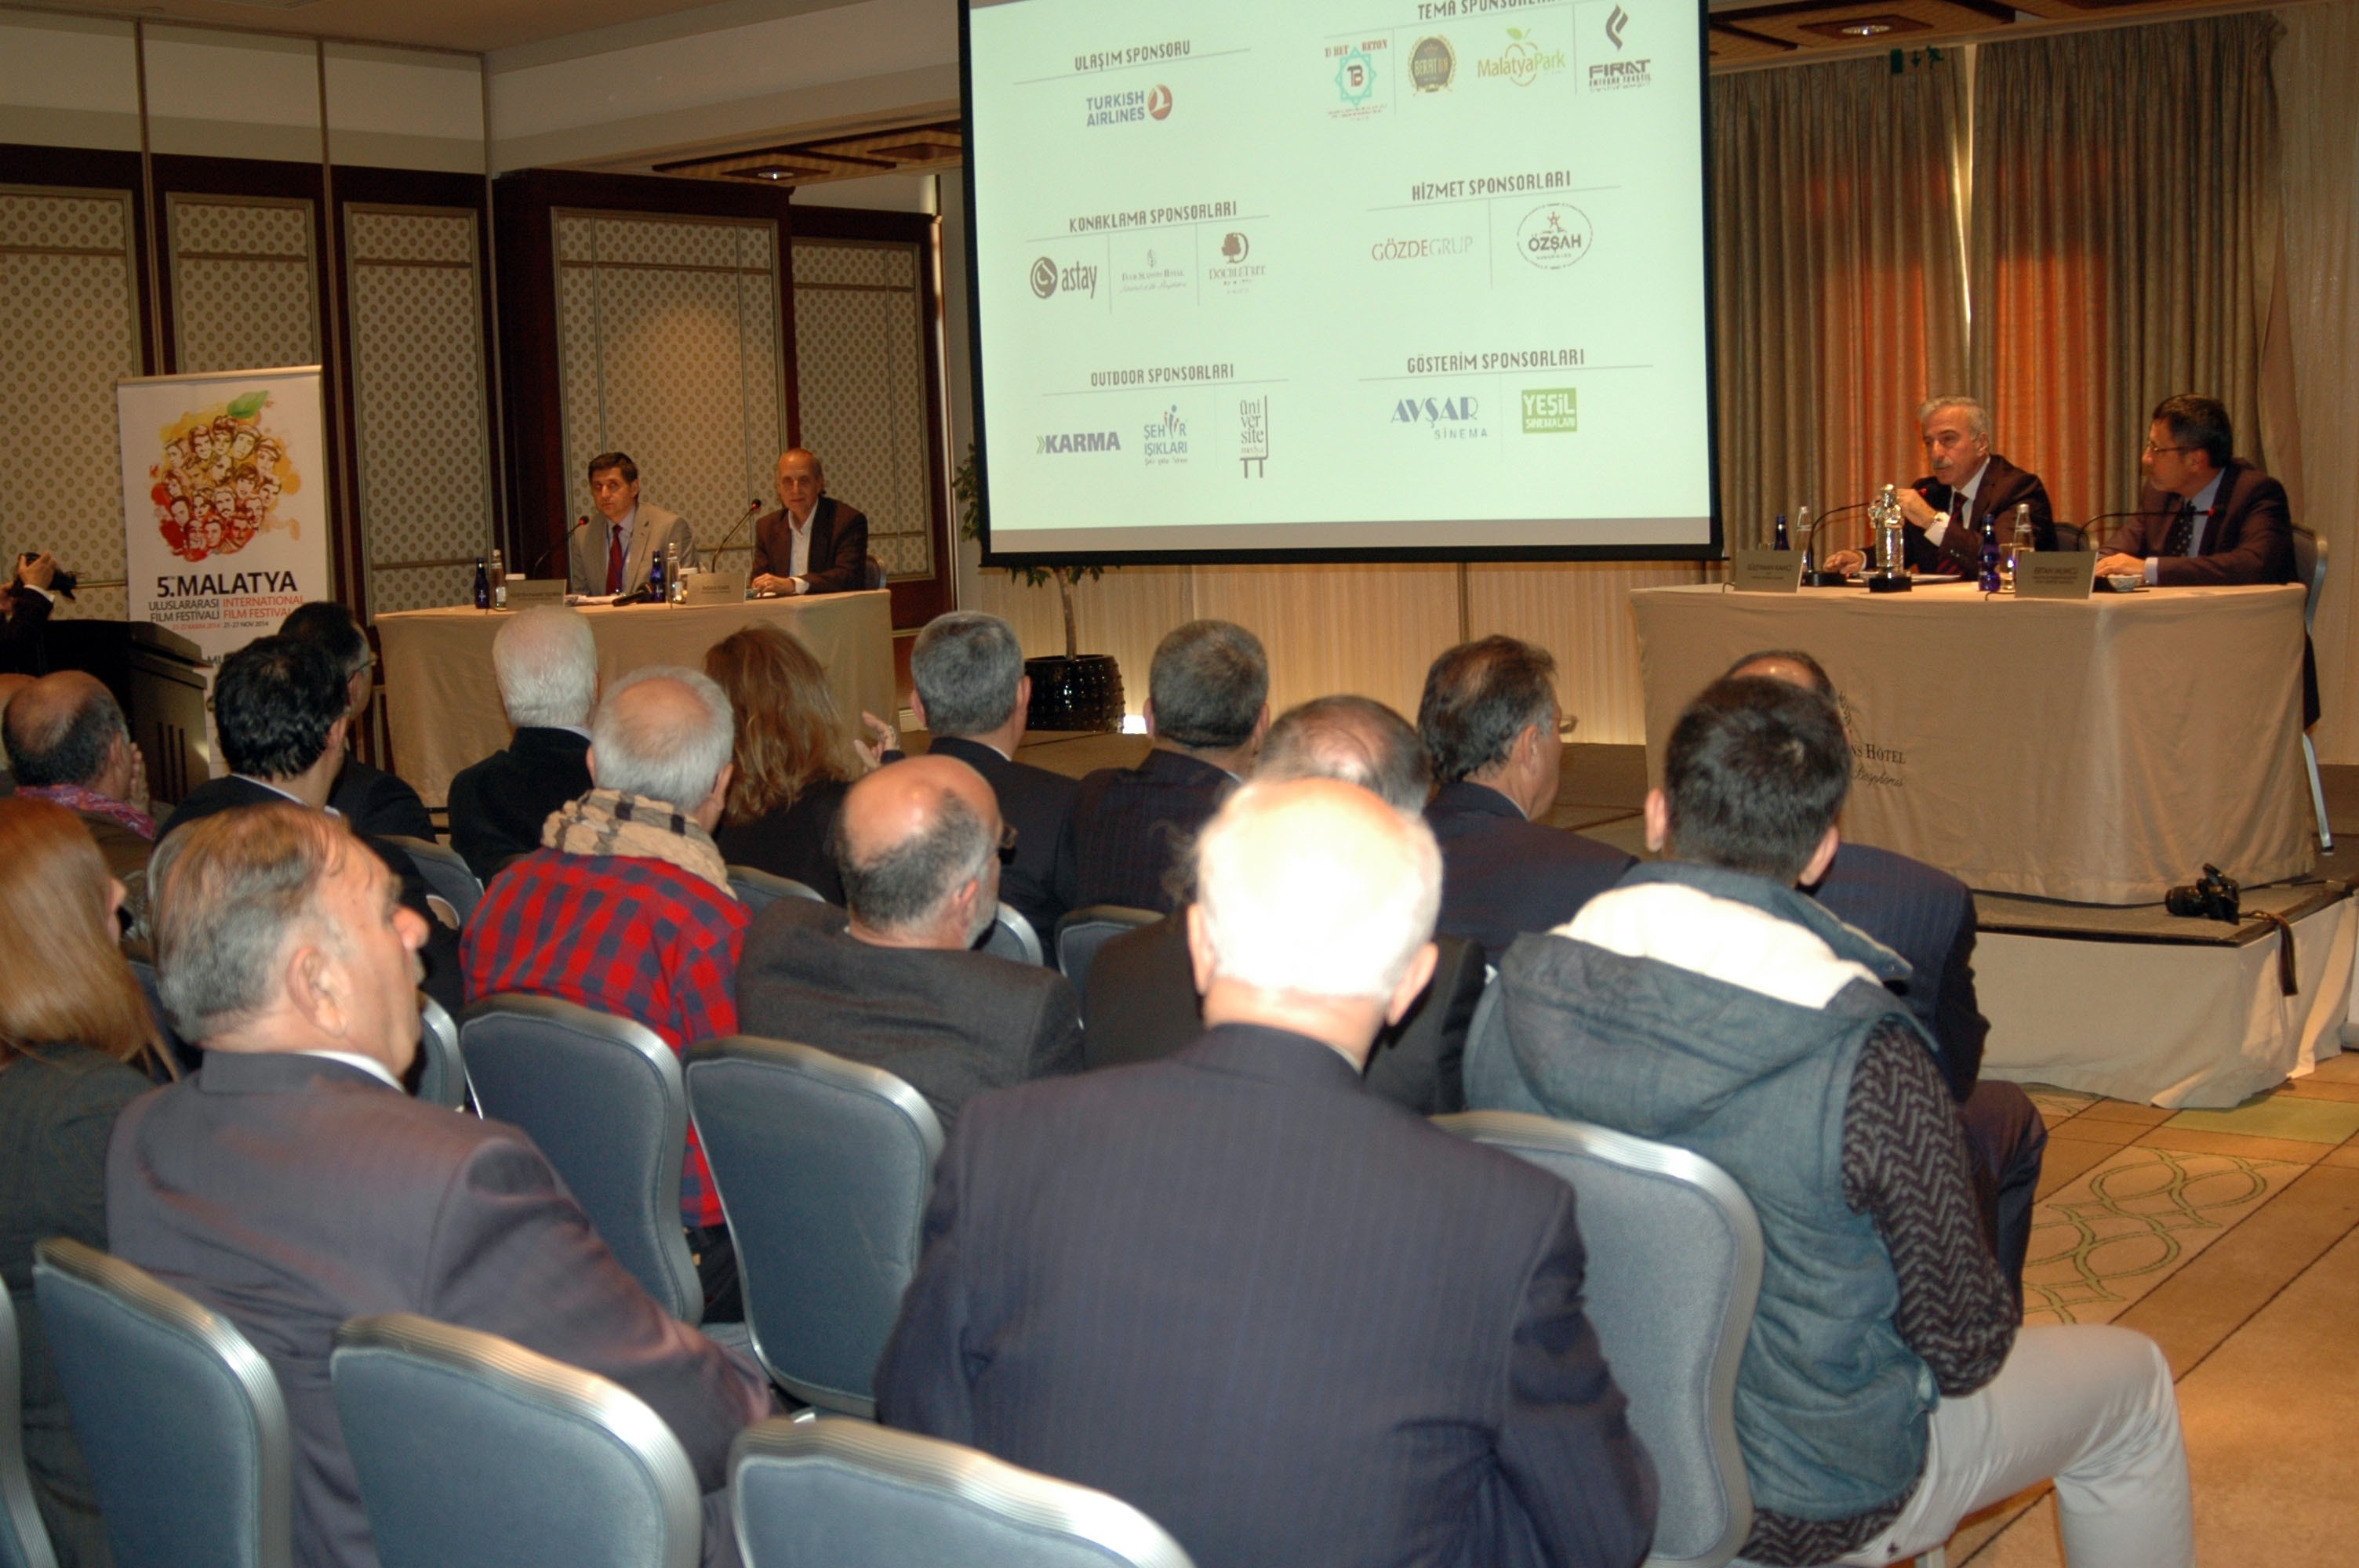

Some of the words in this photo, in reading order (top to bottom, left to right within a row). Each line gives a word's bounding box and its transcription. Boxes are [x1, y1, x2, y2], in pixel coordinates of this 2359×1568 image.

[1418, 2, 1456, 20] TEMA
[1074, 50, 1123, 71] ULAŞIM
[1126, 40, 1190, 65] SPONSORU
[1589, 59, 1651, 79] FIRAT
[1086, 91, 1144, 111] TURKISH
[1087, 107, 1145, 127] AIRLINES
[1412, 180, 1464, 201] HİZMET
[1469, 170, 1571, 196] SPONSORLARI
[1069, 211, 1147, 233] KONAKLAMA
[1150, 201, 1237, 224] SPONSORLARI
[1062, 260, 1097, 299] astay
[1408, 351, 1477, 374] GÖSTERİM
[1482, 349, 1585, 370] SPONSORLARI
[1091, 369, 1144, 387] OUTDOOR
[1148, 364, 1234, 383] SPONSORLARI
[1390, 397, 1478, 428] AVŞAR
[1045, 432, 1121, 454] KARMA
[1241, 427, 1264, 445] site
[148, 599, 220, 612] ULUSLARARASI
[223, 595, 304, 608] INTERNATIONAL
[223, 609, 247, 619] FILM
[1866, 743, 1906, 764] HOTEL
